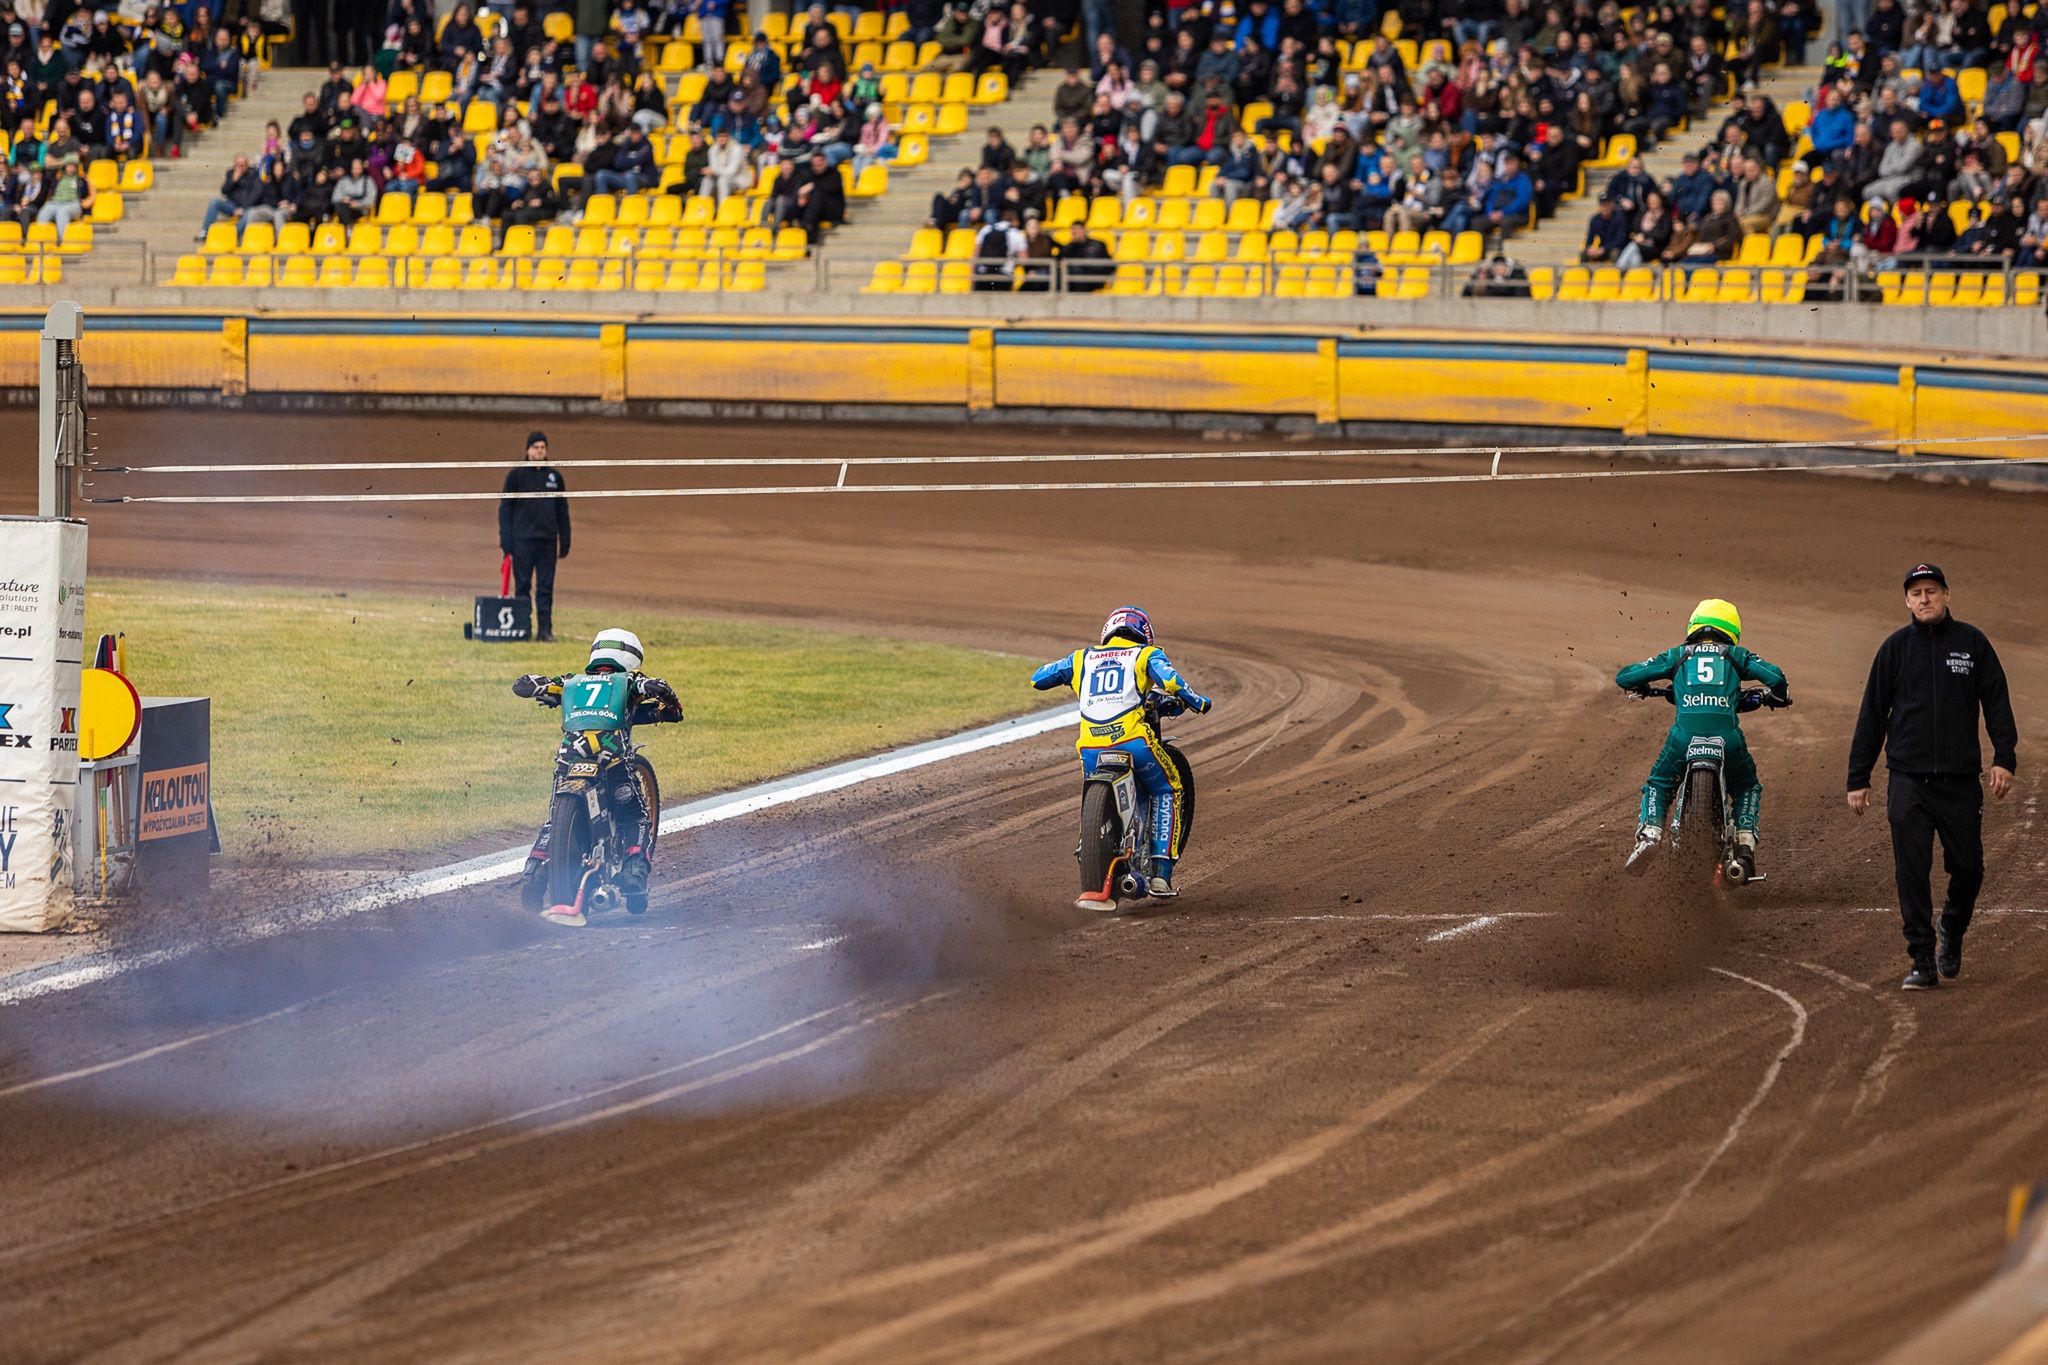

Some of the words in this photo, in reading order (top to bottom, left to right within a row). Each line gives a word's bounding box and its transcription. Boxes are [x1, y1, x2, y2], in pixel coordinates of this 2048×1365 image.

[0, 604, 9, 612] ET
[14, 604, 38, 612] PALETY
[1089, 650, 1133, 660] LAMBERT
[1697, 657, 1714, 683] 5
[1096, 669, 1119, 693] 10
[585, 683, 602, 706] 7
[1683, 693, 1729, 708] Stelmet
[570, 710, 597, 719] ZIELONA
[598, 710, 618, 720] GÓRA
[1688, 745, 1722, 757] Stelmet
[572, 762, 595, 774] 595
[1160, 793, 1173, 841] daytona
[0, 833, 17, 872] Y
